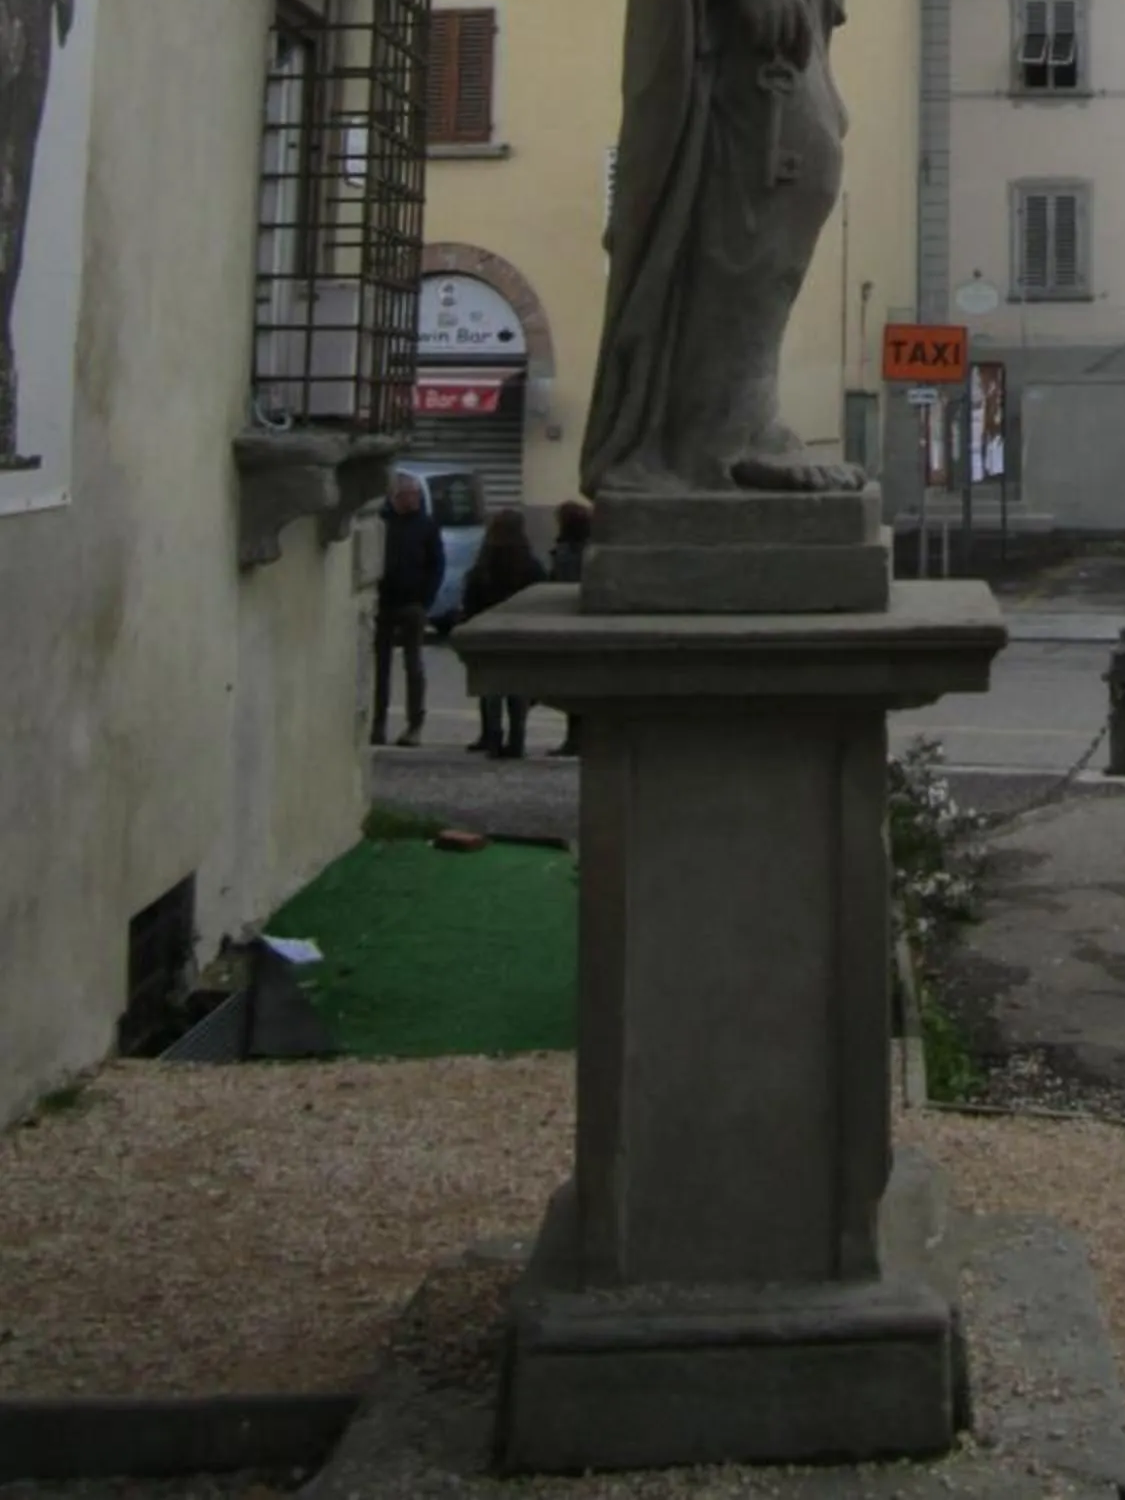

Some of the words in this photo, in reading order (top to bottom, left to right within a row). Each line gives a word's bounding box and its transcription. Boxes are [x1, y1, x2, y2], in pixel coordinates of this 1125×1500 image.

[457, 328, 493, 343] Bar
[890, 340, 960, 367] TAXI
[426, 389, 457, 408] Bar
